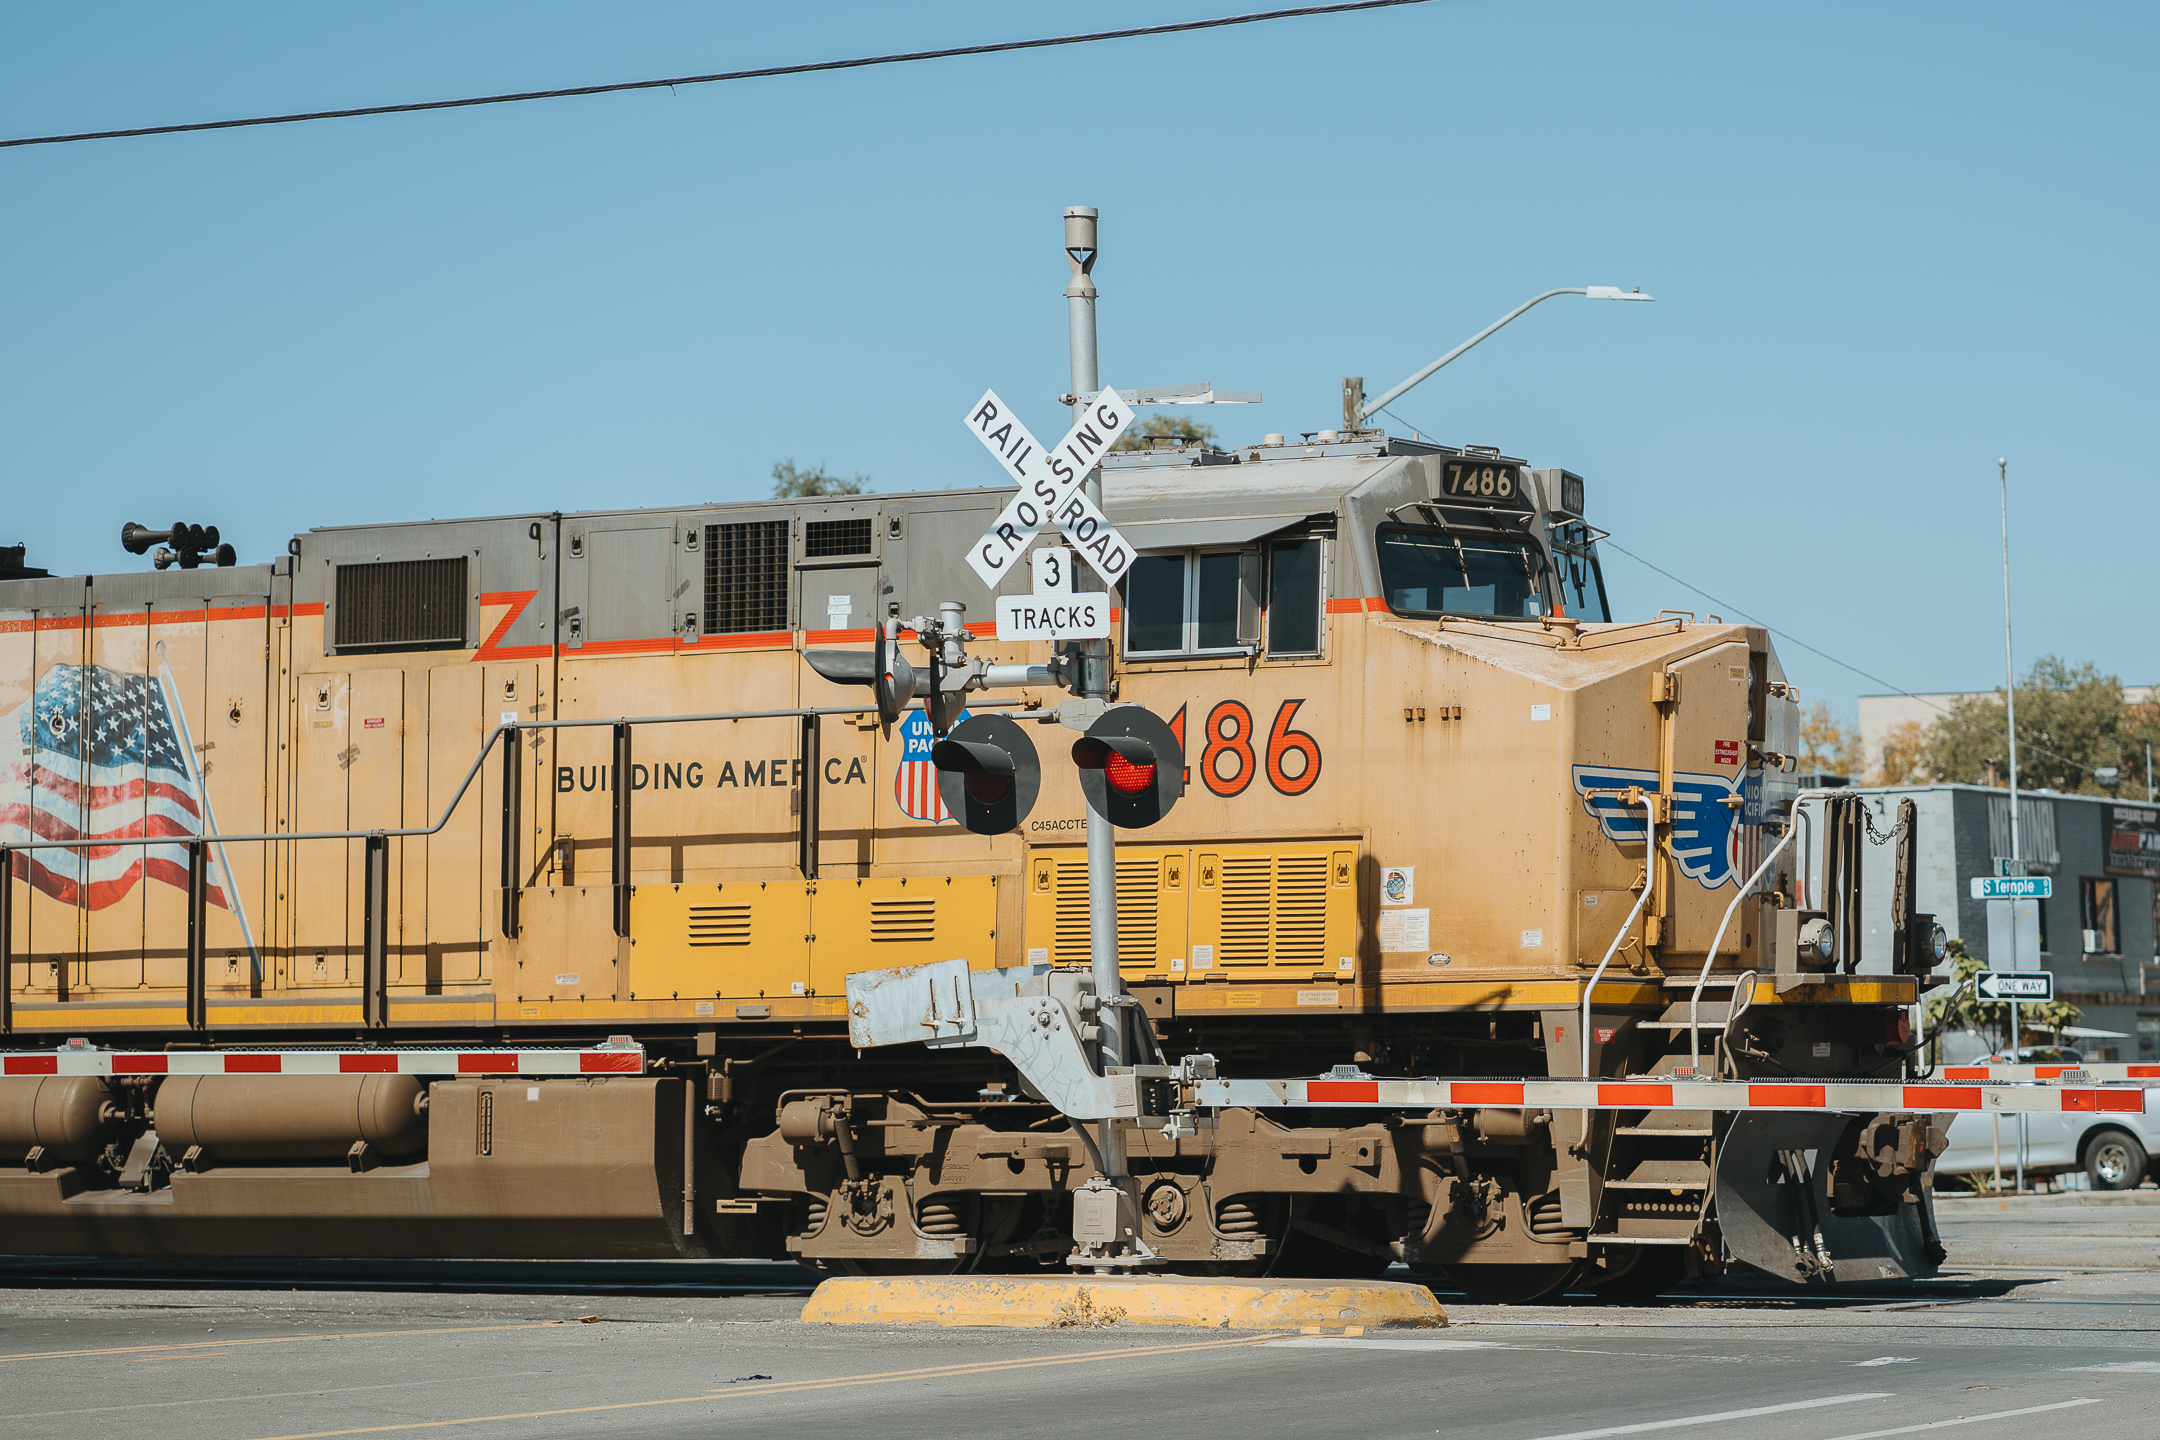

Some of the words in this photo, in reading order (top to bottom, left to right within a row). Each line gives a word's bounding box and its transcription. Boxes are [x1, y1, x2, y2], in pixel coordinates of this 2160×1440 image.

[973, 399, 1032, 477] RAIL
[982, 404, 1119, 569] CROSSING
[1449, 464, 1512, 497] 7486
[1563, 477, 1582, 512] 7486
[1060, 498, 1126, 574] ROAD
[1044, 556, 1061, 587] 3
[1011, 606, 1096, 630] TRACKS
[1168, 698, 1322, 798] 86
[557, 761, 704, 793] BUIDING
[1987, 796, 2059, 864] NAIONAL
[1984, 879, 1991, 893] S
[1994, 879, 2035, 896] Temple
[1998, 981, 2018, 992] ONE
[2022, 981, 2043, 992] WAY
[1555, 1026, 1564, 1043] F
